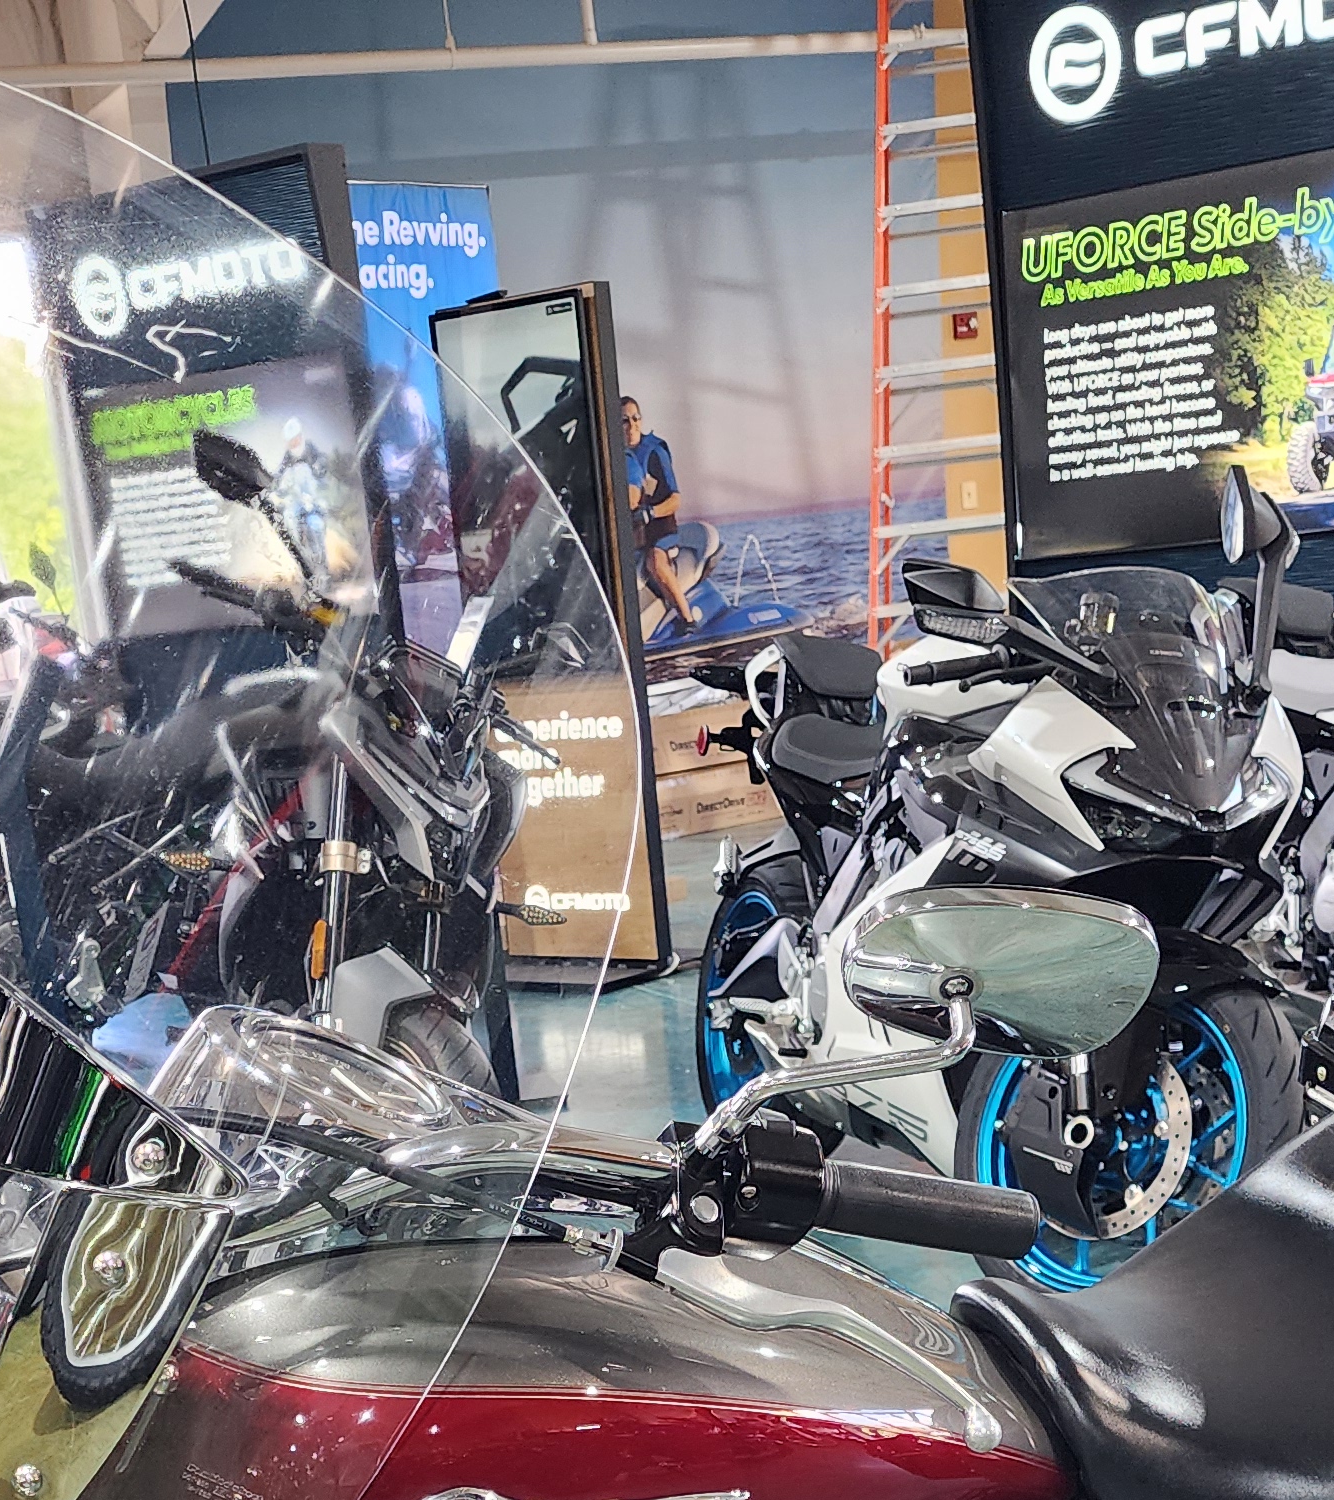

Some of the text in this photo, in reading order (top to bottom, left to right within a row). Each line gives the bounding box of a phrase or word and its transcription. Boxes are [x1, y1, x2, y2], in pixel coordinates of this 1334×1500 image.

[382, 210, 487, 258] Revving.
[1021, 209, 1187, 283] UFORCE
[126, 238, 308, 311] CFMOTO
[359, 254, 435, 299] acing.
[1040, 254, 1250, 307] As Versatile As You Are.
[1073, 371, 1121, 392] UFORCE
[527, 767, 605, 807] gether
[550, 893, 630, 911] CFMOTO
